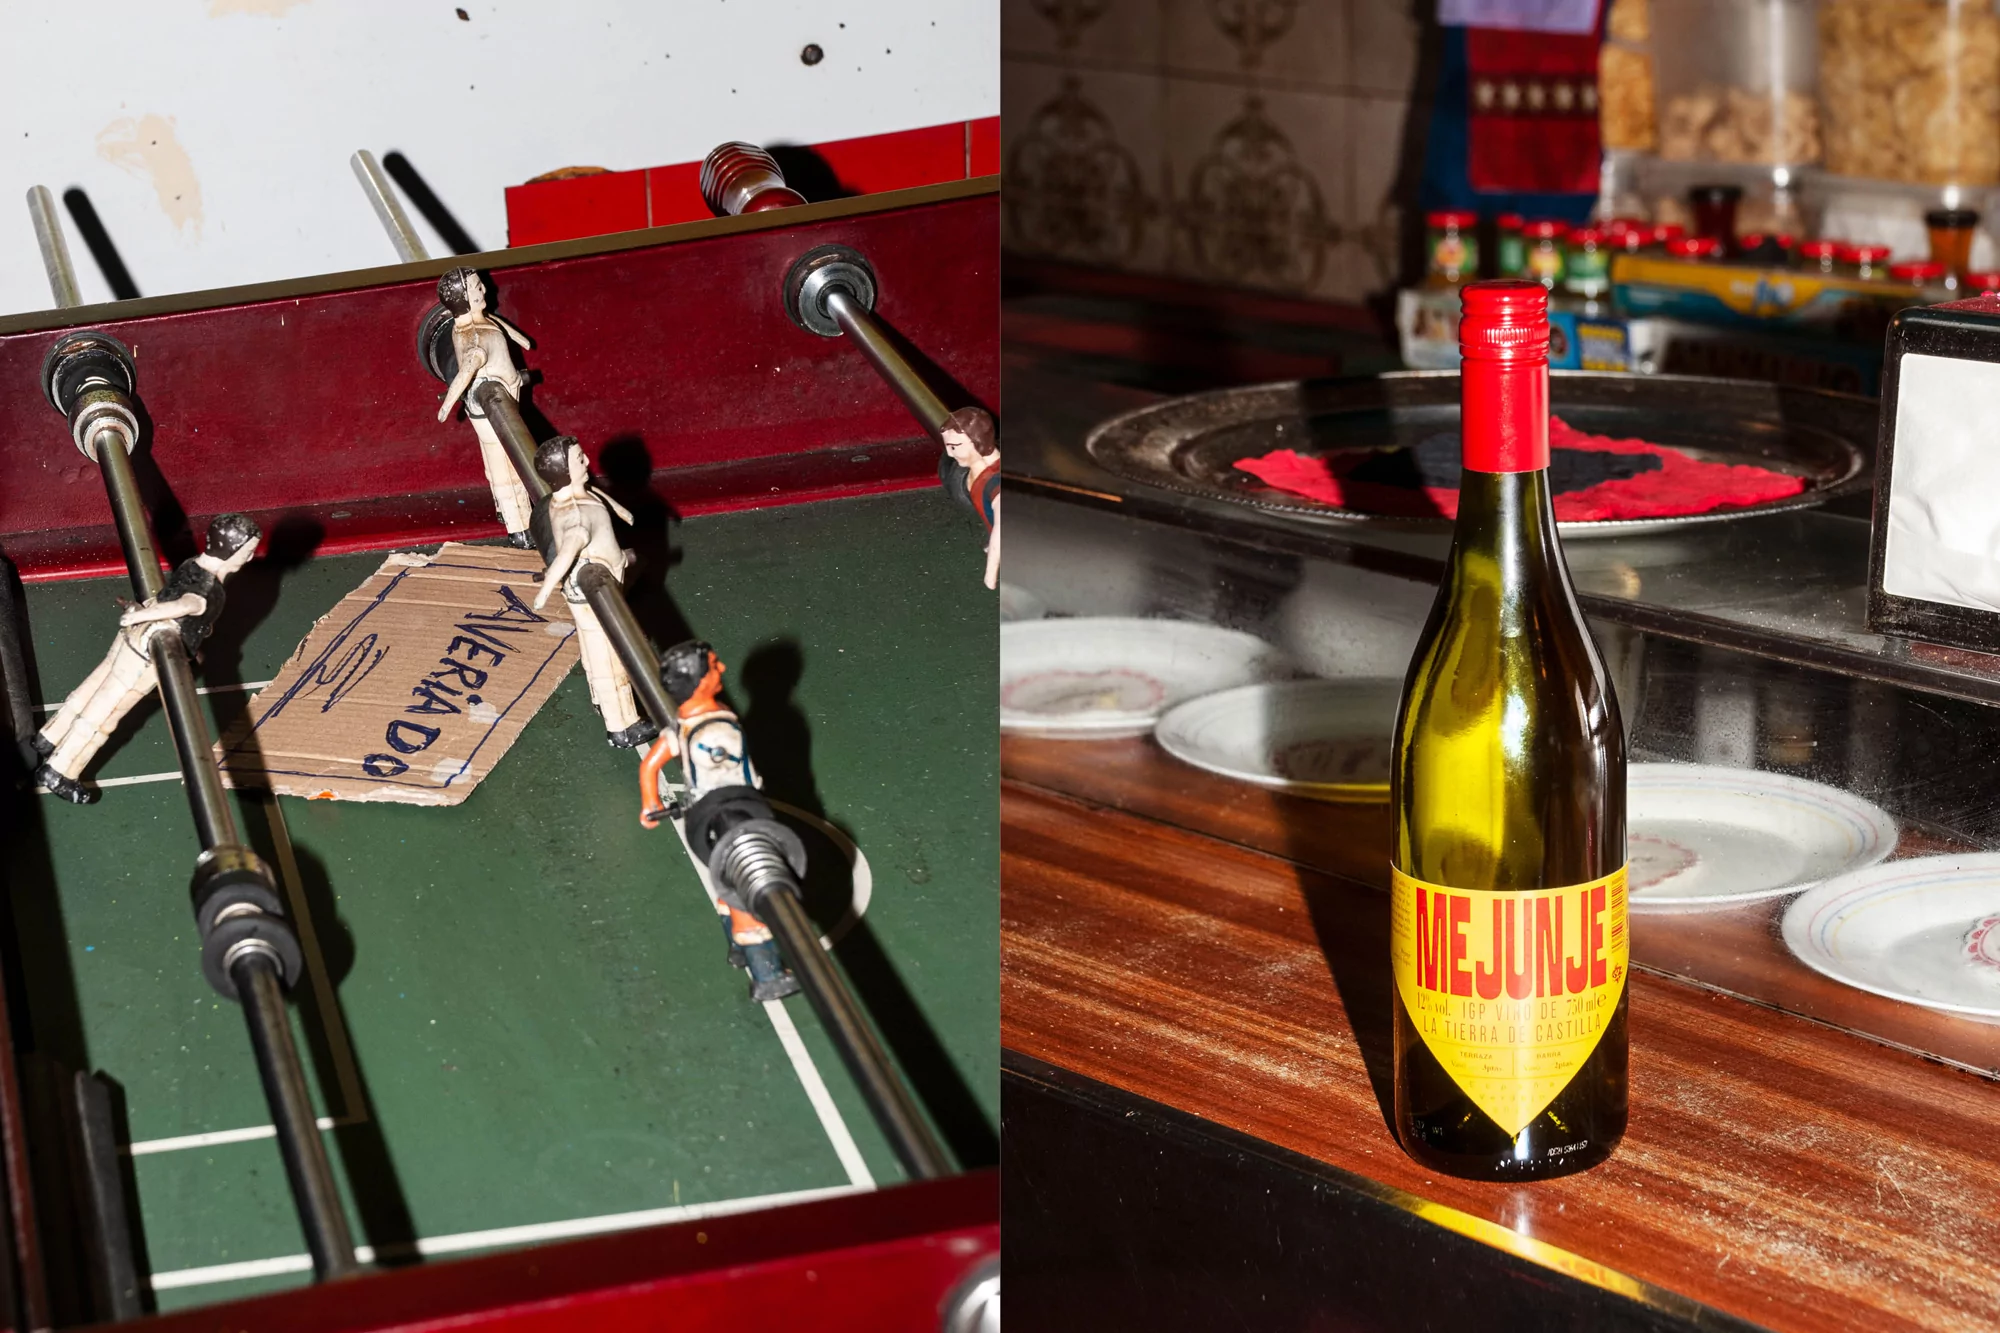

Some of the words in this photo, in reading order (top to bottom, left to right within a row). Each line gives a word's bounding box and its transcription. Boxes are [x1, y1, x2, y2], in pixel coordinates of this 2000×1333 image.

[1416, 885, 1607, 1000] MEJUNJE
[1462, 1001, 1486, 1020] IGP
[1495, 1002, 1531, 1021] VINO
[1541, 1001, 1557, 1020] DE
[1566, 995, 1584, 1016] 750
[1423, 1015, 1438, 1035] LA
[1445, 1020, 1498, 1043] TIERRA
[1508, 1025, 1526, 1043] DE
[1536, 1013, 1601, 1042] CASTILLA
[1460, 1051, 1493, 1060] TERRAZA
